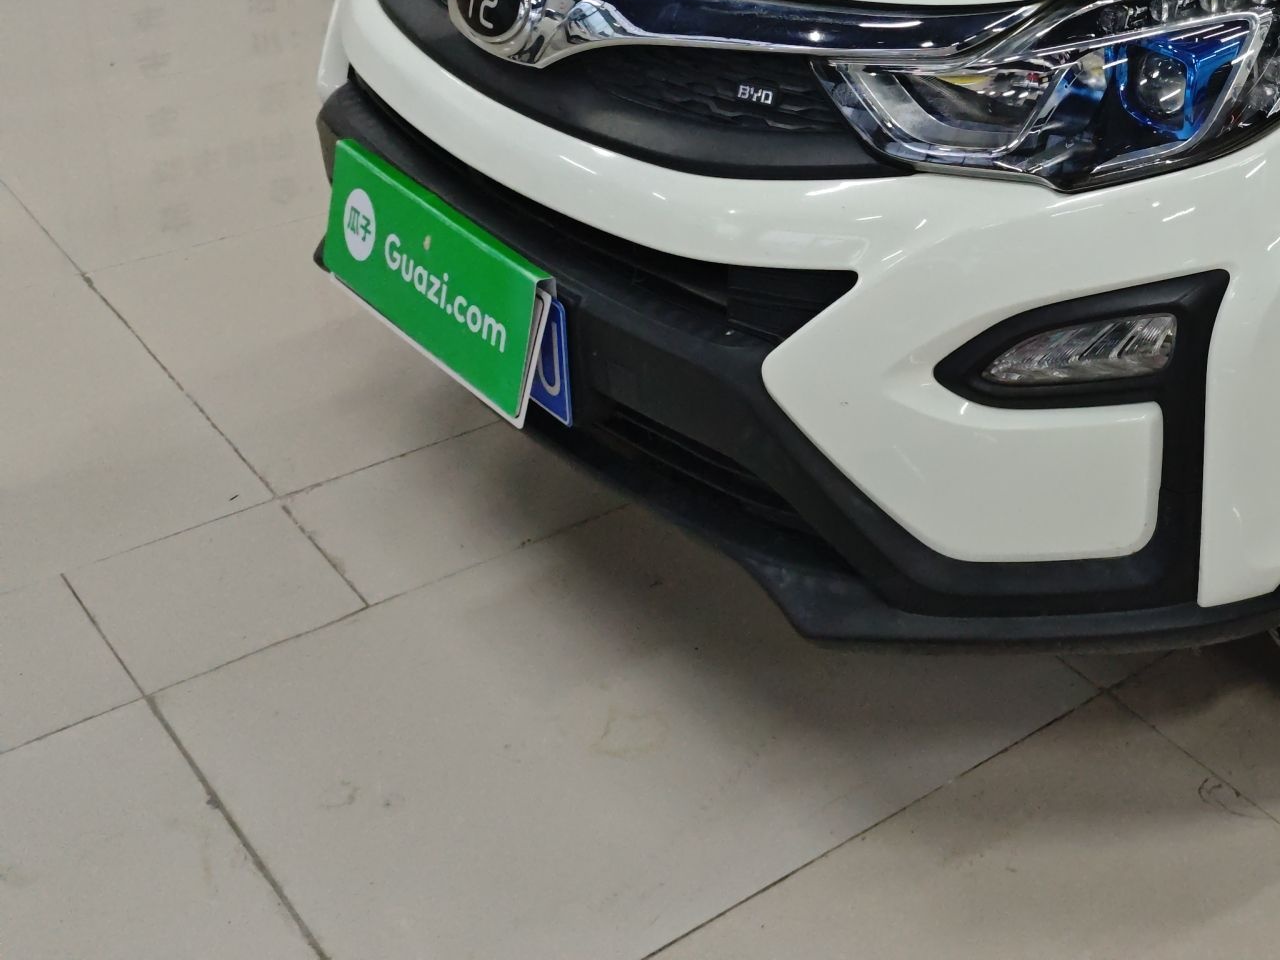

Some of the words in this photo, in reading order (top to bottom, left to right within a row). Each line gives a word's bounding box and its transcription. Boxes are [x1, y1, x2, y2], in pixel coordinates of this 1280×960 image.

[737, 85, 773, 105] BYD
[347, 206, 372, 242] 瓜子
[384, 233, 507, 353] Guazi.com
